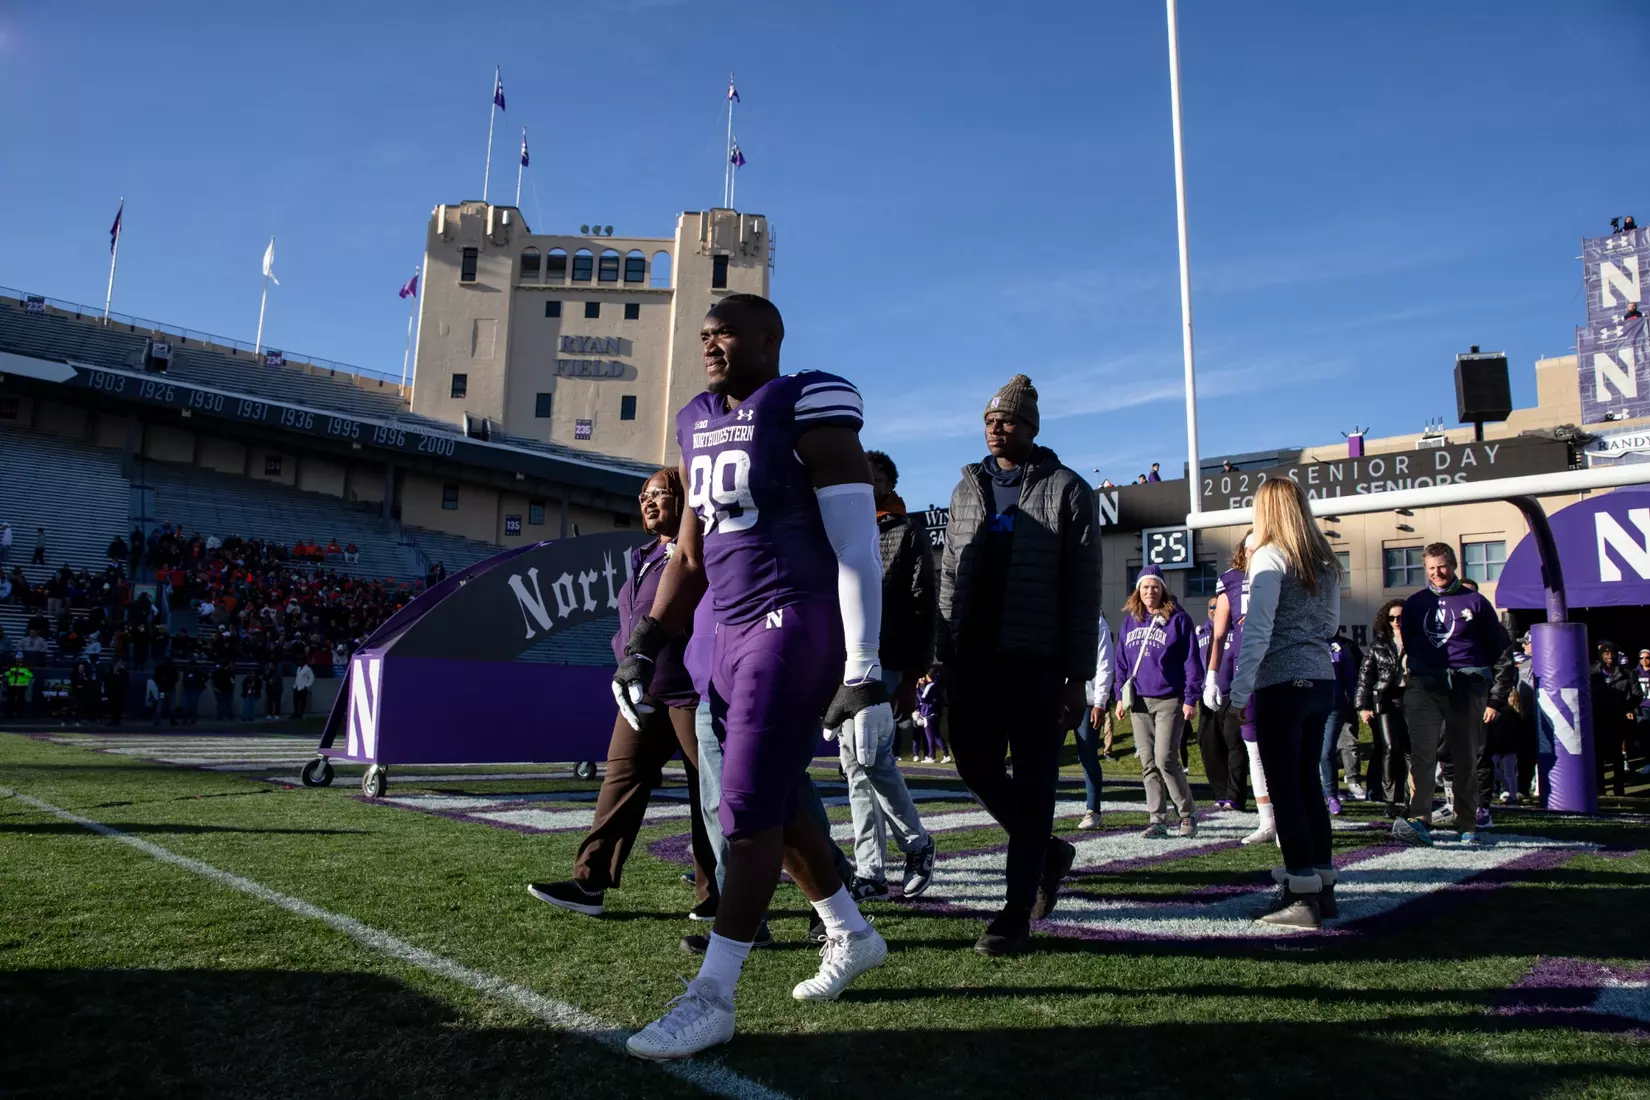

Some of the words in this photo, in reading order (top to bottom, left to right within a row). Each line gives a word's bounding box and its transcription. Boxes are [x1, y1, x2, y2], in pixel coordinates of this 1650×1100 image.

[1600, 255, 1642, 308] N
[559, 335, 623, 354] RYAN
[553, 359, 624, 378] FIELD
[1593, 347, 1637, 402] N
[88, 370, 126, 392] 1903
[139, 380, 176, 402] 1926
[189, 390, 225, 412] 1930
[237, 399, 268, 421] 1931
[280, 408, 315, 429] 1936
[327, 417, 360, 438] 1995
[373, 426, 407, 447] 1996
[418, 435, 455, 456] 2000
[576, 425, 591, 435] 235
[693, 425, 755, 449] NORTHWESTERN
[1204, 472, 1267, 496] 2022
[1288, 456, 1409, 485] SENIOR
[1435, 444, 1499, 470] DAY
[688, 450, 759, 535] 99
[1099, 491, 1119, 526] N
[507, 521, 520, 530] 135
[1151, 532, 1186, 563] 25
[1595, 507, 1650, 583] N
[766, 609, 783, 629] N
[1434, 608, 1446, 623] N
[348, 659, 381, 759] N
[1537, 687, 1582, 754] N
